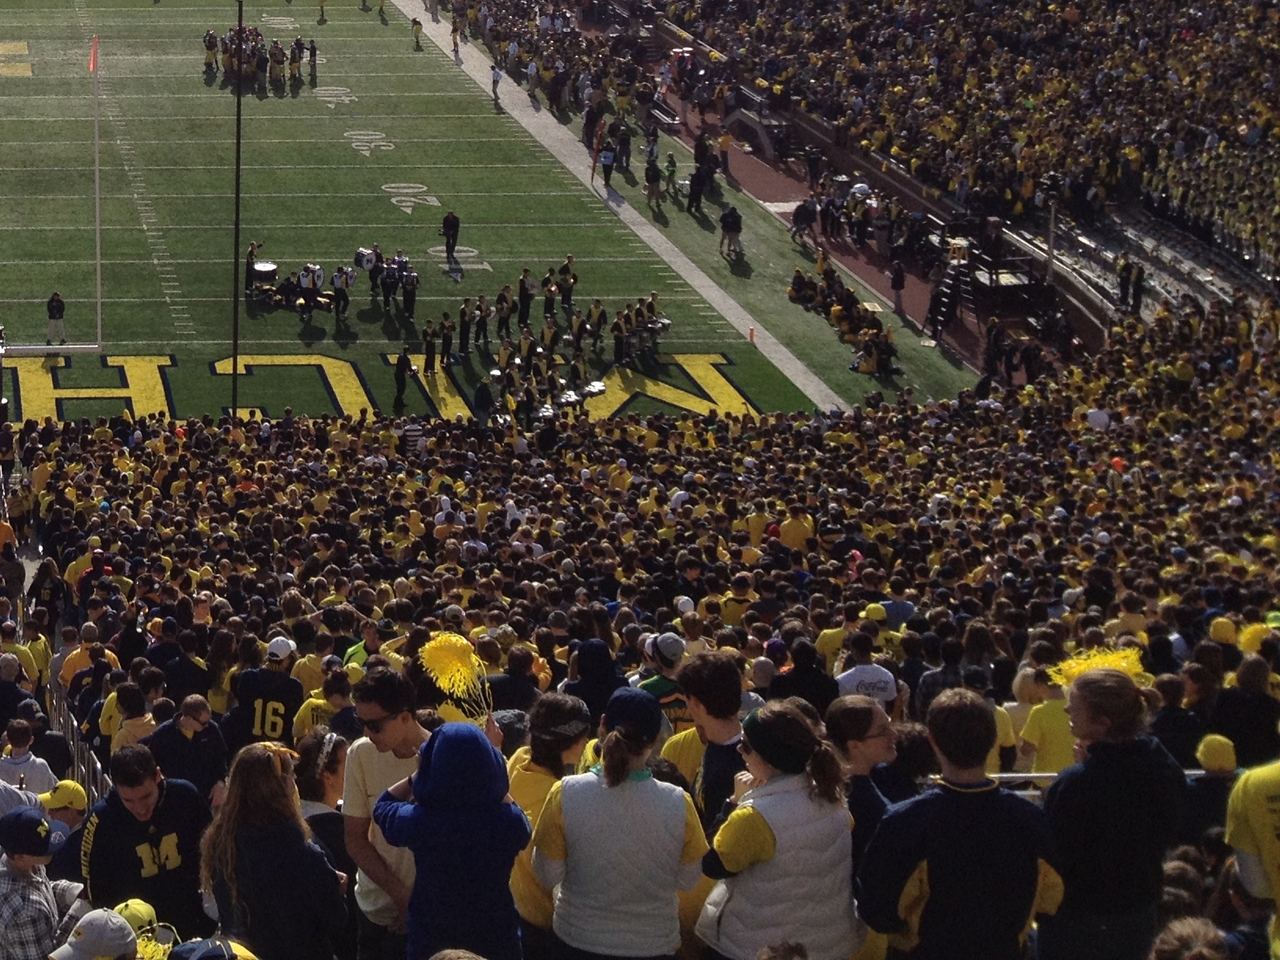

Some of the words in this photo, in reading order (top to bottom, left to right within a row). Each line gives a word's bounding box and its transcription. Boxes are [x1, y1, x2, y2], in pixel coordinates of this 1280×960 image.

[381, 182, 442, 207] 20
[252, 698, 285, 739] 16
[81, 812, 100, 879] MICHIGAN
[135, 832, 182, 878] 14
